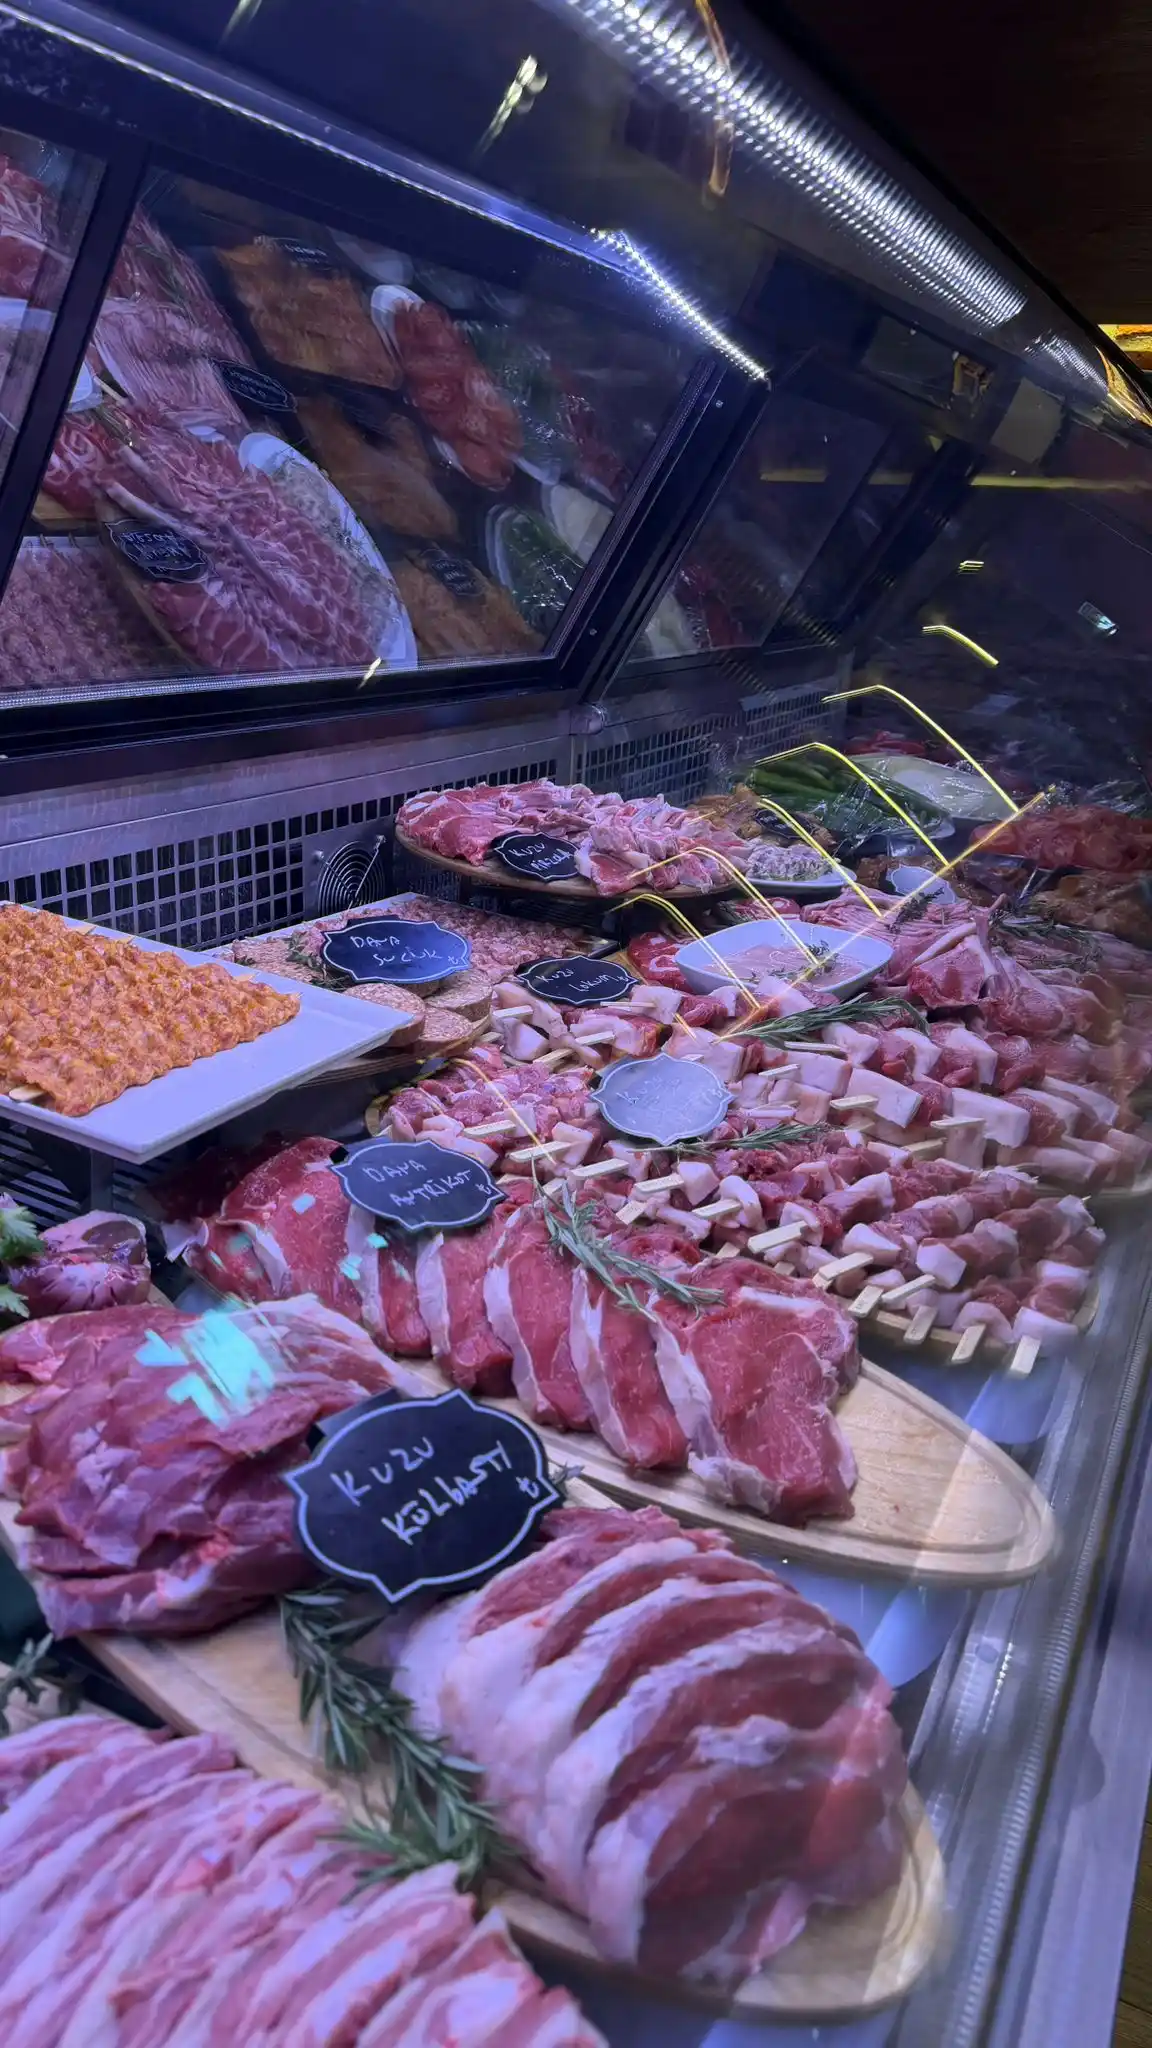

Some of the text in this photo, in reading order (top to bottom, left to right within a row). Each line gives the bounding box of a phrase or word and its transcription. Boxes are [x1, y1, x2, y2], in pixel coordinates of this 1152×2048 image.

[507, 842, 546, 858] KUZU
[349, 935, 401, 948] DANA
[534, 968, 575, 984] KUZU
[362, 1159, 428, 1183] DANA
[330, 1436, 435, 1507] KUZU
